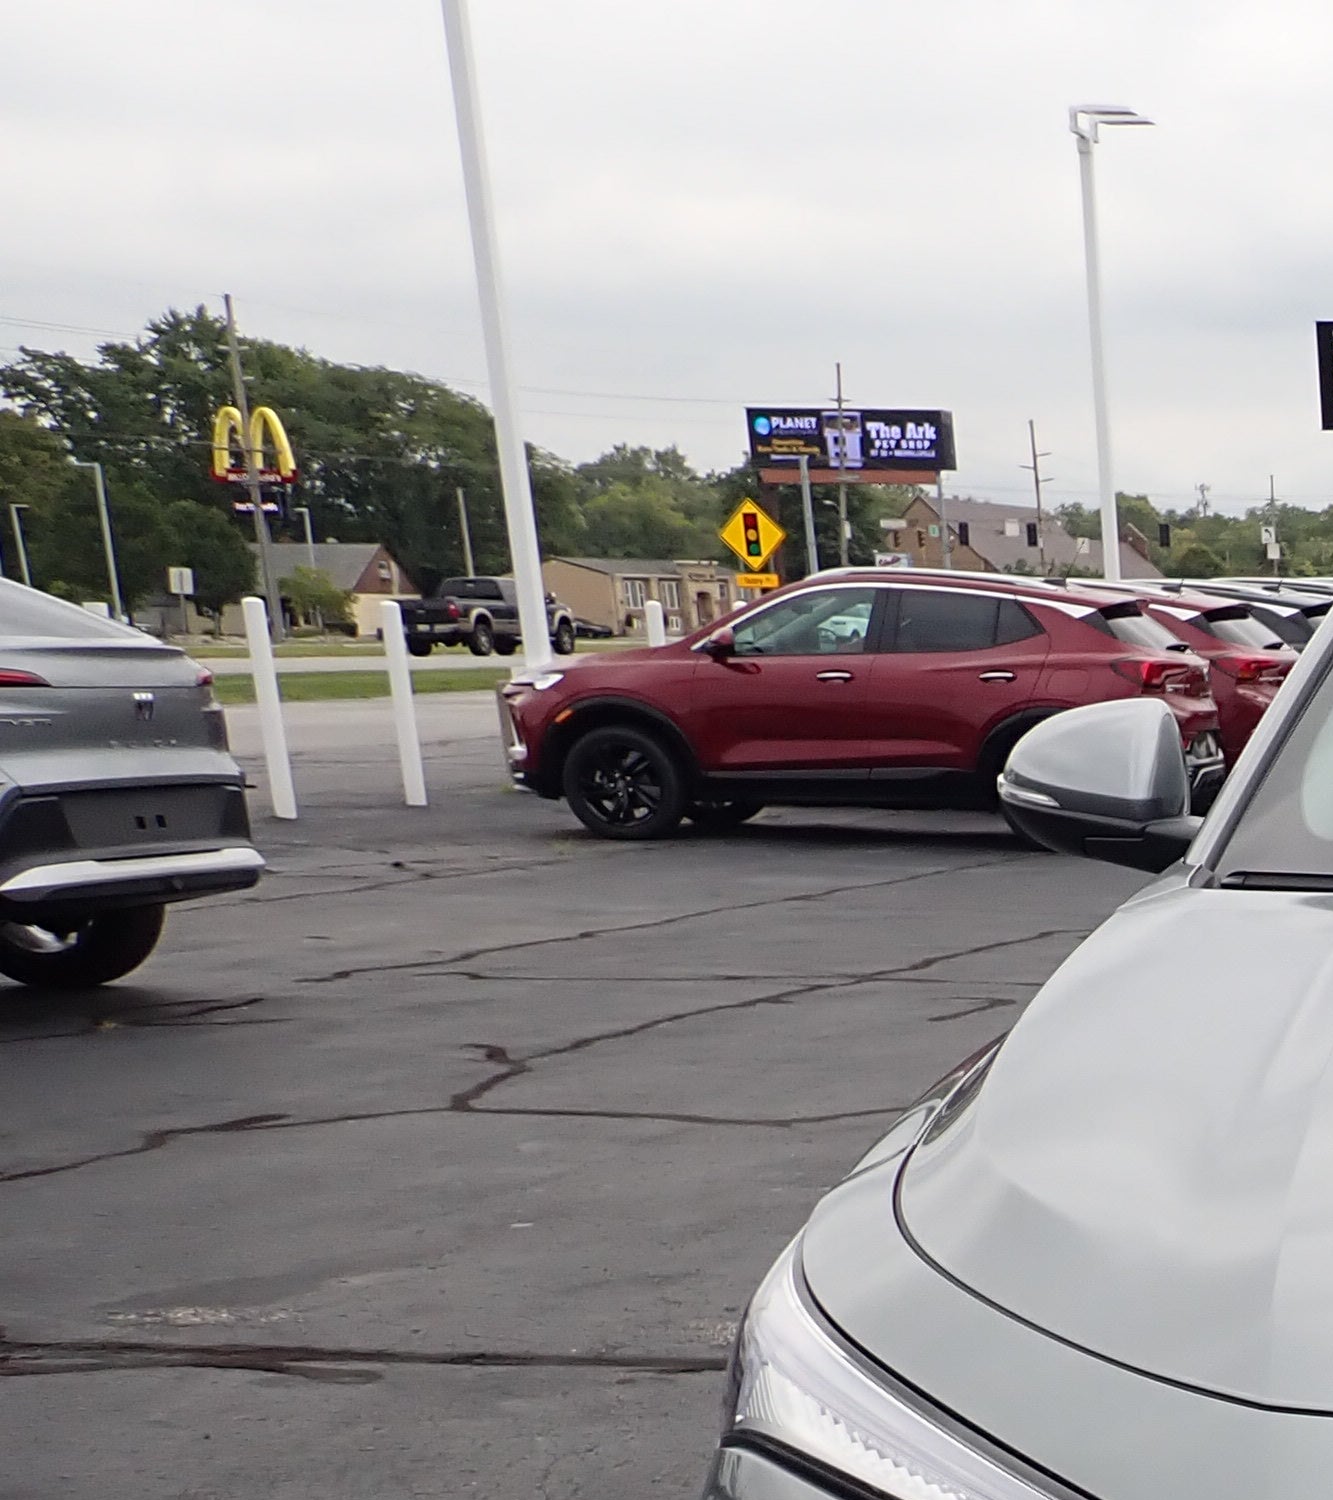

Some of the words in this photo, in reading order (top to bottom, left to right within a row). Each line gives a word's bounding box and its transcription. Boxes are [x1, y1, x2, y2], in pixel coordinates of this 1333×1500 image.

[770, 416, 817, 428] PLANET
[866, 422, 902, 439] The
[905, 422, 937, 439] Ark
[900, 440, 931, 449] SHOP
